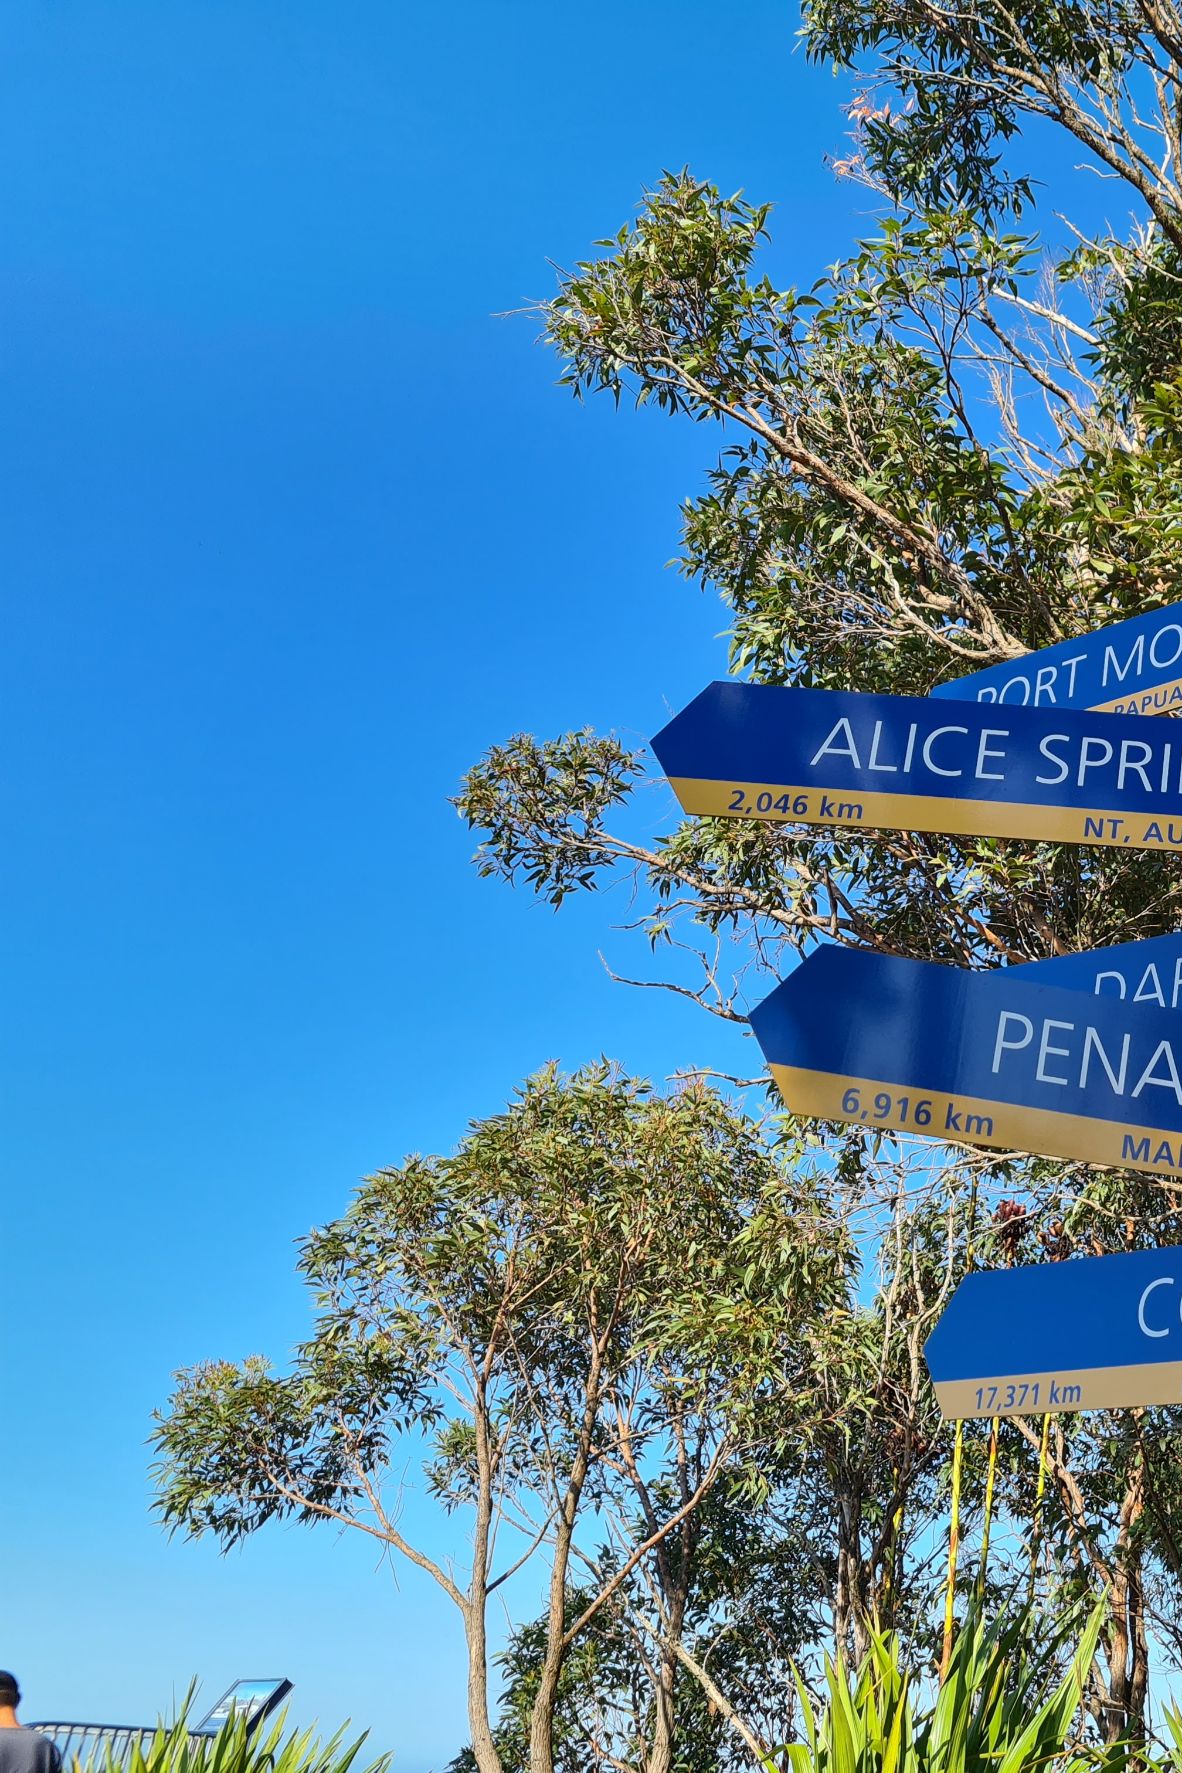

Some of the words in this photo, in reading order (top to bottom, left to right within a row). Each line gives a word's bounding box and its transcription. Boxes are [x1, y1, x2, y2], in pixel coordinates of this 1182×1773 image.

[810, 716, 1010, 783] ALICE
[727, 789, 810, 817] 2,046
[820, 793, 864, 821] km
[1083, 817, 1131, 845] NT,
[841, 1087, 933, 1127] 6,916
[944, 1102, 995, 1138] km
[975, 1382, 1041, 1411] 17,371
[1049, 1379, 1082, 1405] km
